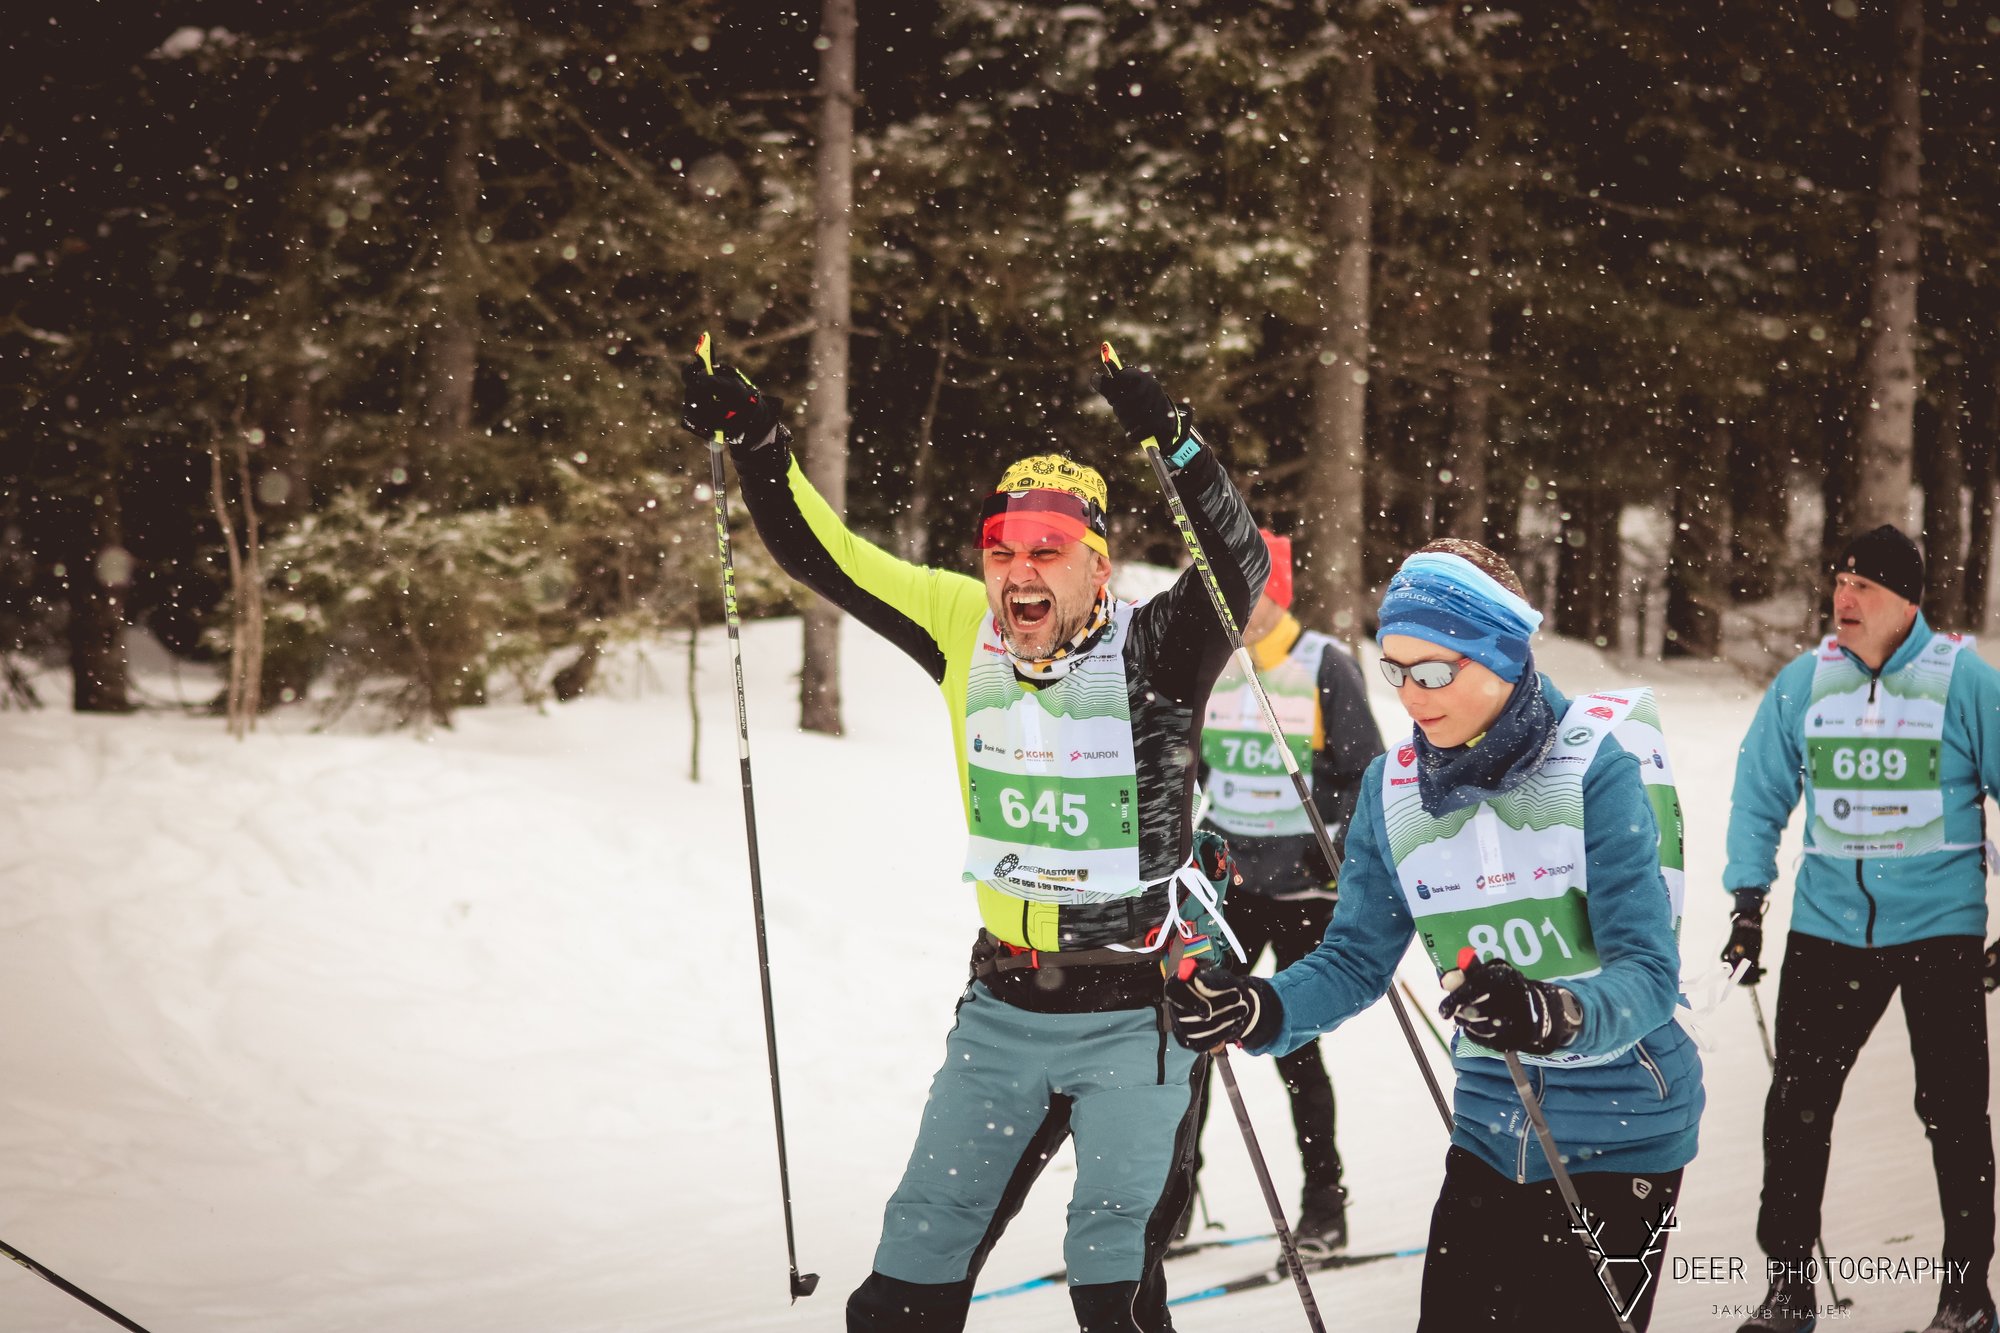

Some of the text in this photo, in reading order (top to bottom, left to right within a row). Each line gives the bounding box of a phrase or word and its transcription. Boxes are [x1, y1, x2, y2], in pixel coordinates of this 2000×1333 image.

[1174, 514, 1208, 570] LEKI
[725, 567, 739, 624] LEKI
[1026, 750, 1054, 759] KGHM
[1082, 750, 1119, 760] TAURON
[1220, 739, 1283, 770] 764
[1832, 747, 1907, 781] 689
[999, 787, 1090, 837] 645
[1121, 821, 1131, 834] CT
[1432, 886, 1444, 894] Bank
[1487, 872, 1516, 885] KGHM
[1467, 917, 1573, 967] 801
